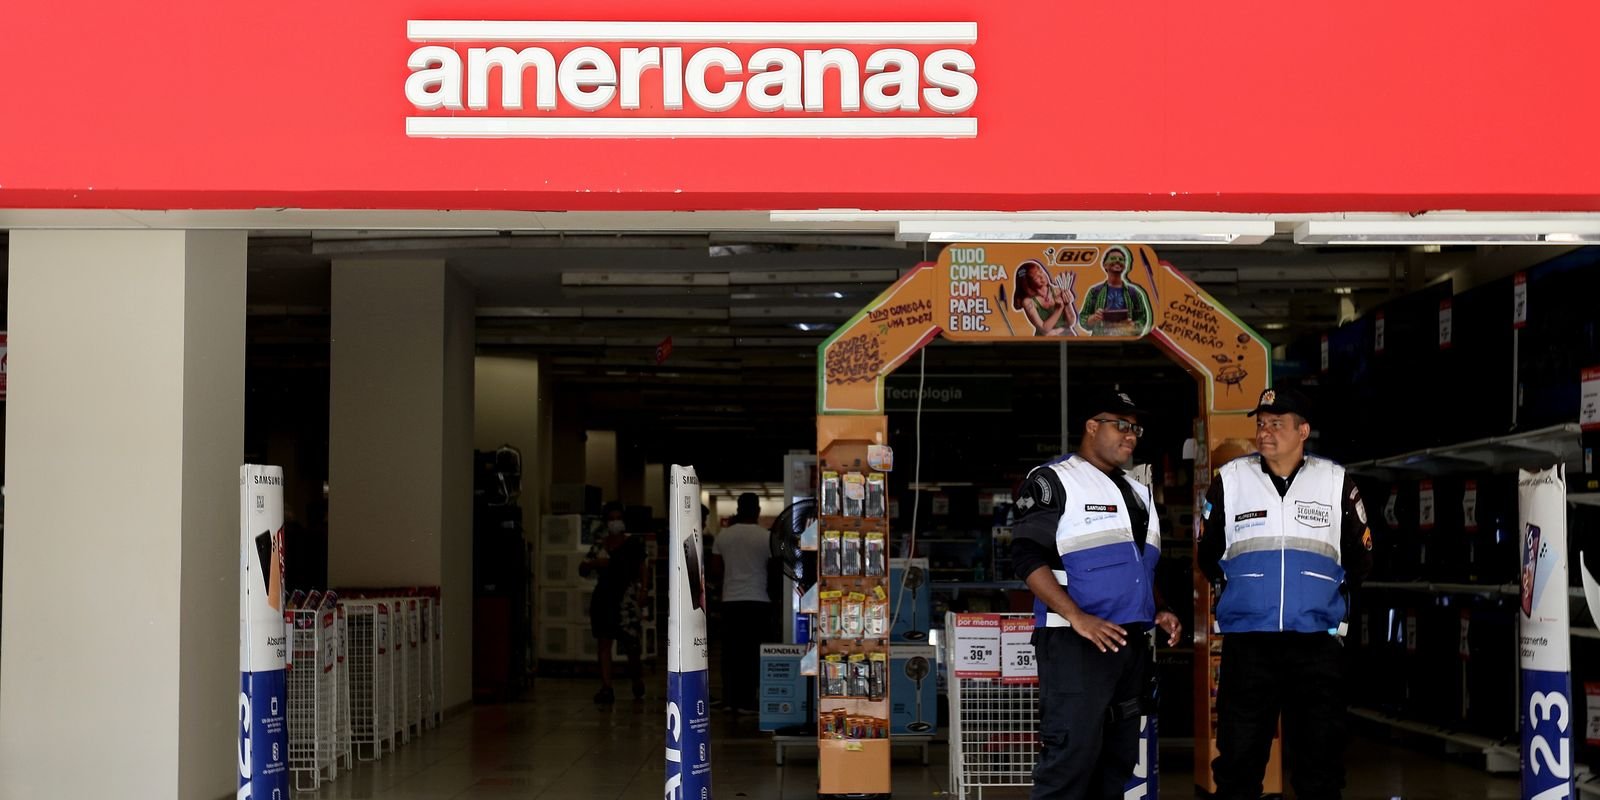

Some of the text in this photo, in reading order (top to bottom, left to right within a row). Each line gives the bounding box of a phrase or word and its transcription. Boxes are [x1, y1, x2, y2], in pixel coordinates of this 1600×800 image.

[404, 45, 978, 113] americanas
[950, 248, 985, 264] TUDO
[950, 265, 1008, 281] COMEÇA
[950, 282, 981, 297] COM
[950, 298, 992, 314] PAPEL
[1184, 293, 1214, 312] TUDO
[950, 315, 990, 331] E BIC.
[1164, 311, 1189, 326] COM
[886, 386, 962, 402] Tecnologia
[957, 618, 999, 627] por menos
[1017, 654, 1036, 666] 39,9
